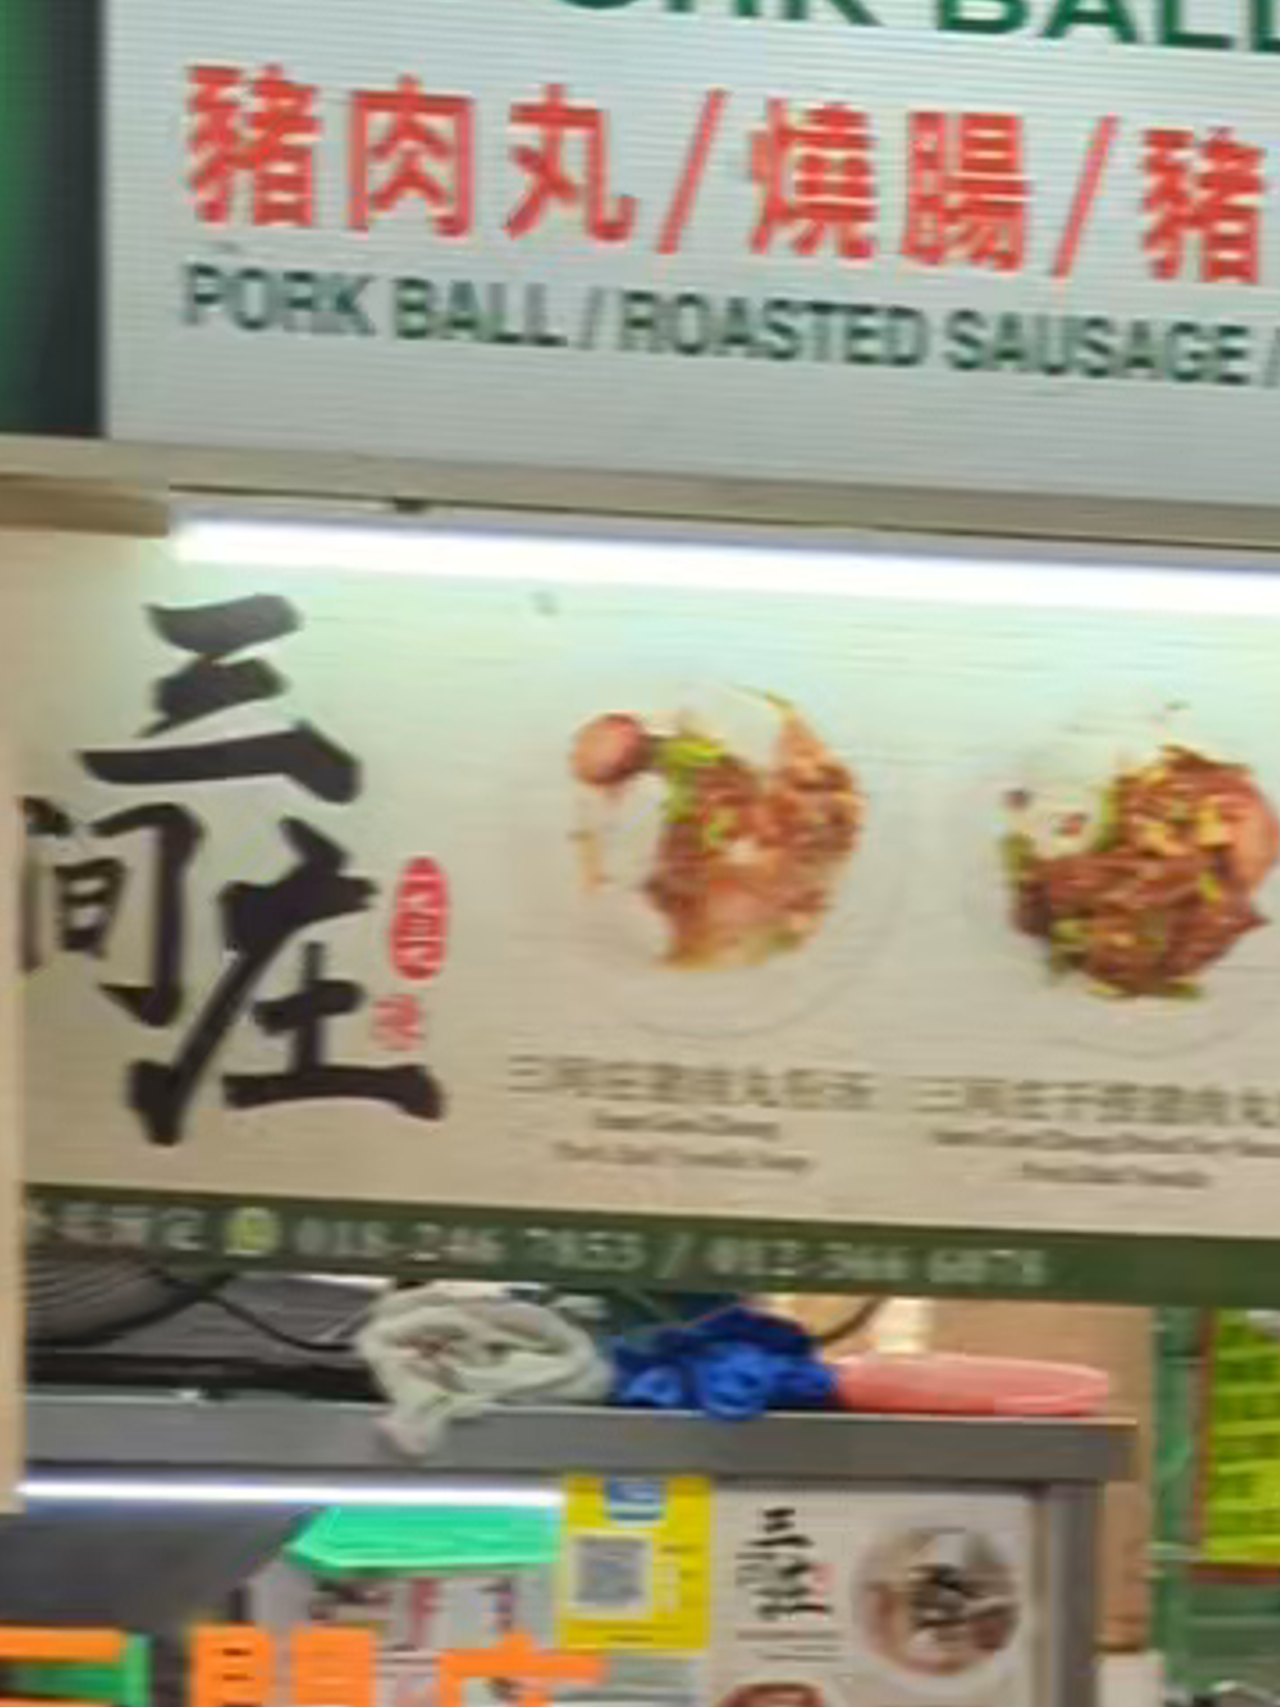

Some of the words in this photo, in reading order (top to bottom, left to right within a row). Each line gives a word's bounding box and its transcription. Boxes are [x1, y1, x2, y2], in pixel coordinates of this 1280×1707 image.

[186, 262, 375, 336] PORK
[392, 275, 568, 348] BALL
[621, 289, 924, 365] ROASTED
[943, 308, 1250, 385] SAUSAGE
